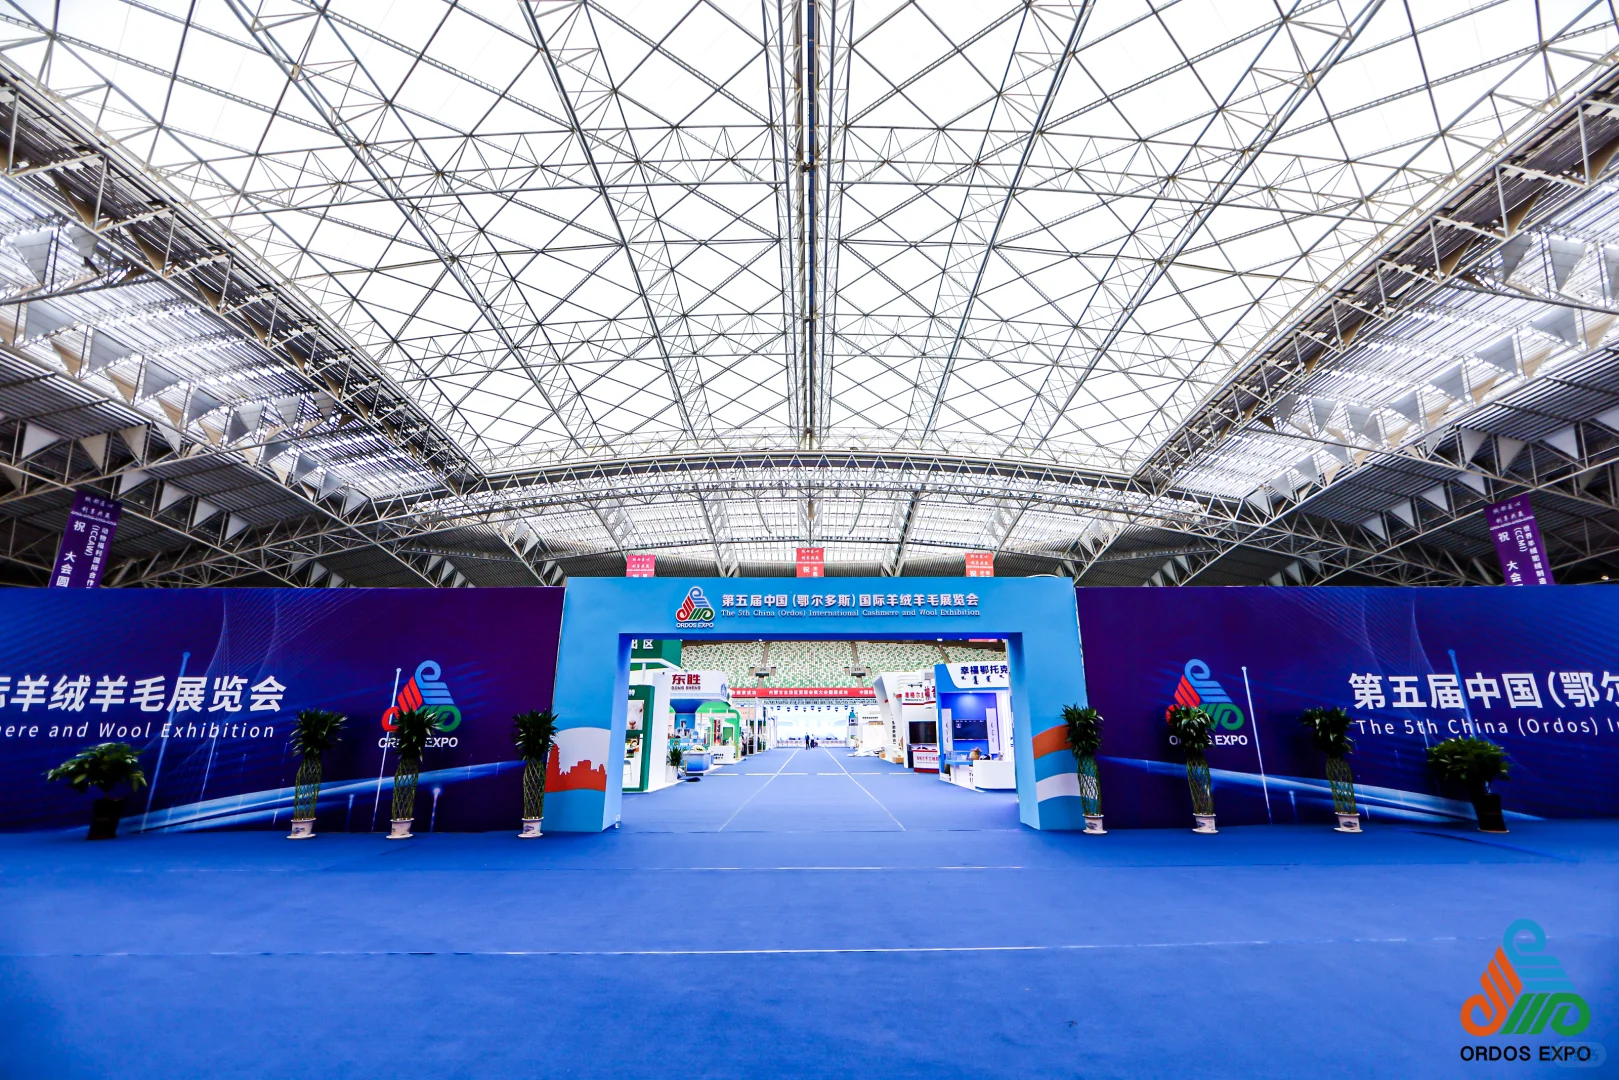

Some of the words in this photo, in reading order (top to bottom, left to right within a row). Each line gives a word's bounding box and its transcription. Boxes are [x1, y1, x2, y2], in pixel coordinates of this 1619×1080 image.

[73, 520, 86, 533] 祝
[86, 527, 109, 589] 动物福利国际合作
[1498, 531, 1511, 543] 祝
[1506, 560, 1524, 587] 大会
[722, 592, 979, 608] 第五届中国(鄂尔多斯)国际羊绒羊毛展览会
[721, 609, 736, 617] The
[738, 609, 750, 617] 5th
[753, 609, 775, 617] China
[778, 609, 806, 617] (Ordos)
[808, 609, 859, 617] International
[862, 609, 900, 617] Cashmere
[902, 609, 916, 617] and
[919, 609, 938, 617] Wool
[940, 609, 980, 617] Exhibition
[960, 664, 1009, 675] 幸福鄂托克
[671, 674, 701, 685] 东胜
[0, 721, 39, 739] ere
[48, 721, 89, 738] and
[100, 721, 152, 739] Wool
[160, 721, 275, 739] Exhibition
[1356, 719, 1395, 735] The
[1404, 719, 1439, 735] 5th
[1448, 718, 1509, 735] China
[1517, 718, 1600, 737] (Ordos)
[424, 736, 459, 748] EXPO
[1214, 734, 1248, 746] EXPO
